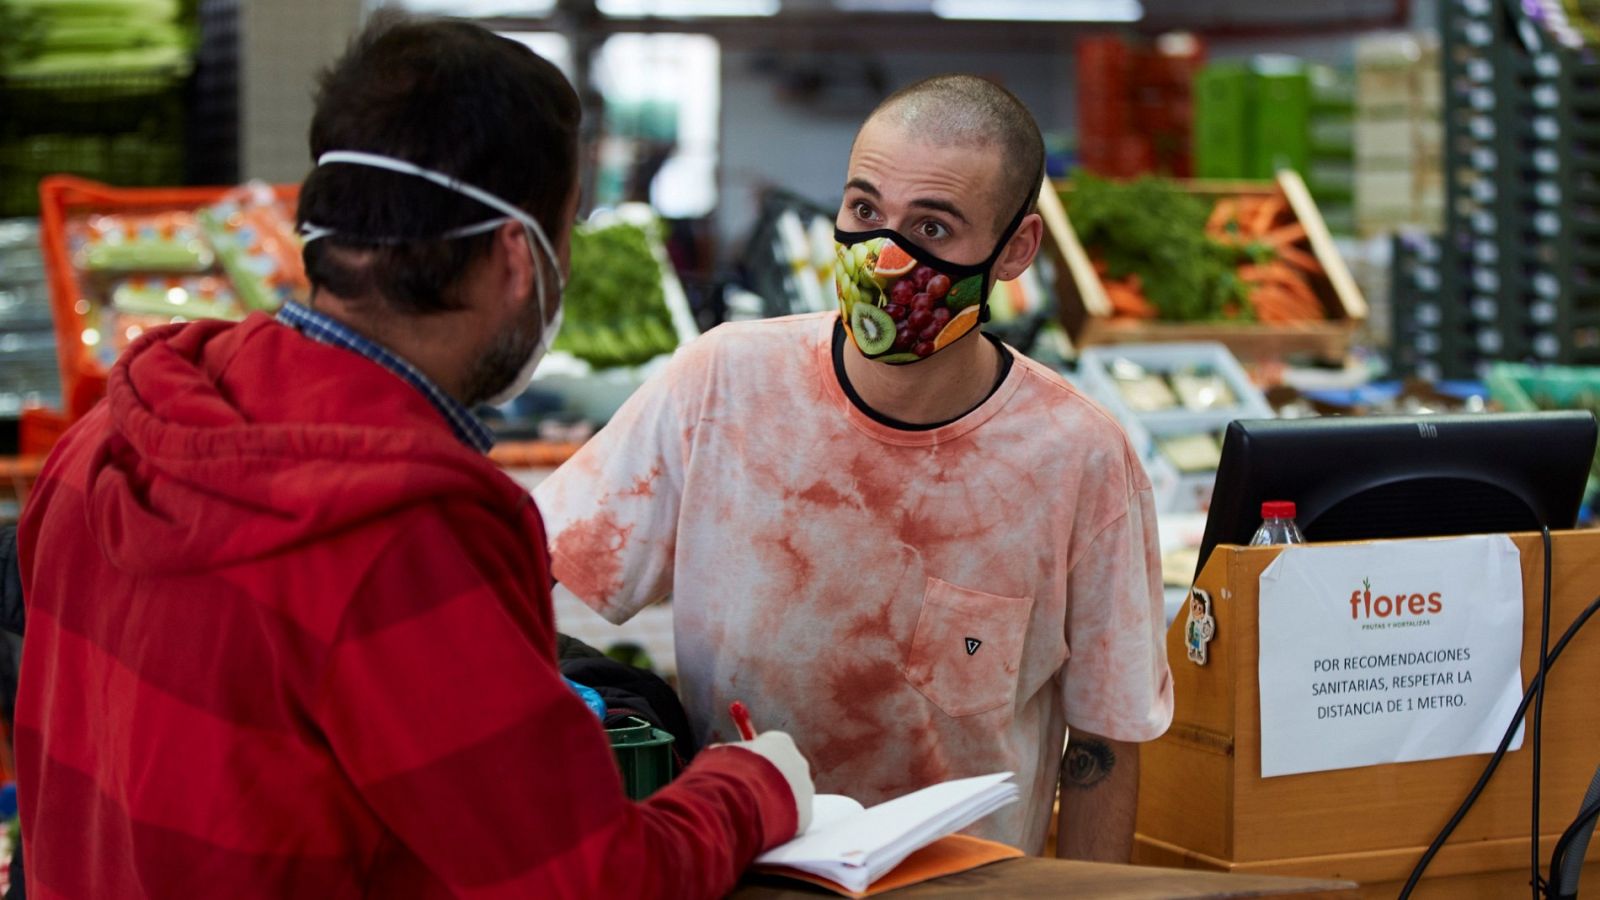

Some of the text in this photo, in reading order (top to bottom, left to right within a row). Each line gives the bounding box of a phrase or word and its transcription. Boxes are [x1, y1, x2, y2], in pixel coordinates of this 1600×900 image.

[1350, 579, 1442, 619] flores
[1362, 622, 1385, 630] FRUTAS
[1393, 620, 1431, 628] HORTALIZAS
[1314, 648, 1471, 672] POR RECOMENDACIONES
[1312, 670, 1472, 696] SANITARIAS, RESPETAR LA
[1317, 694, 1466, 719] DISTANCIA DE 1 METRO.
